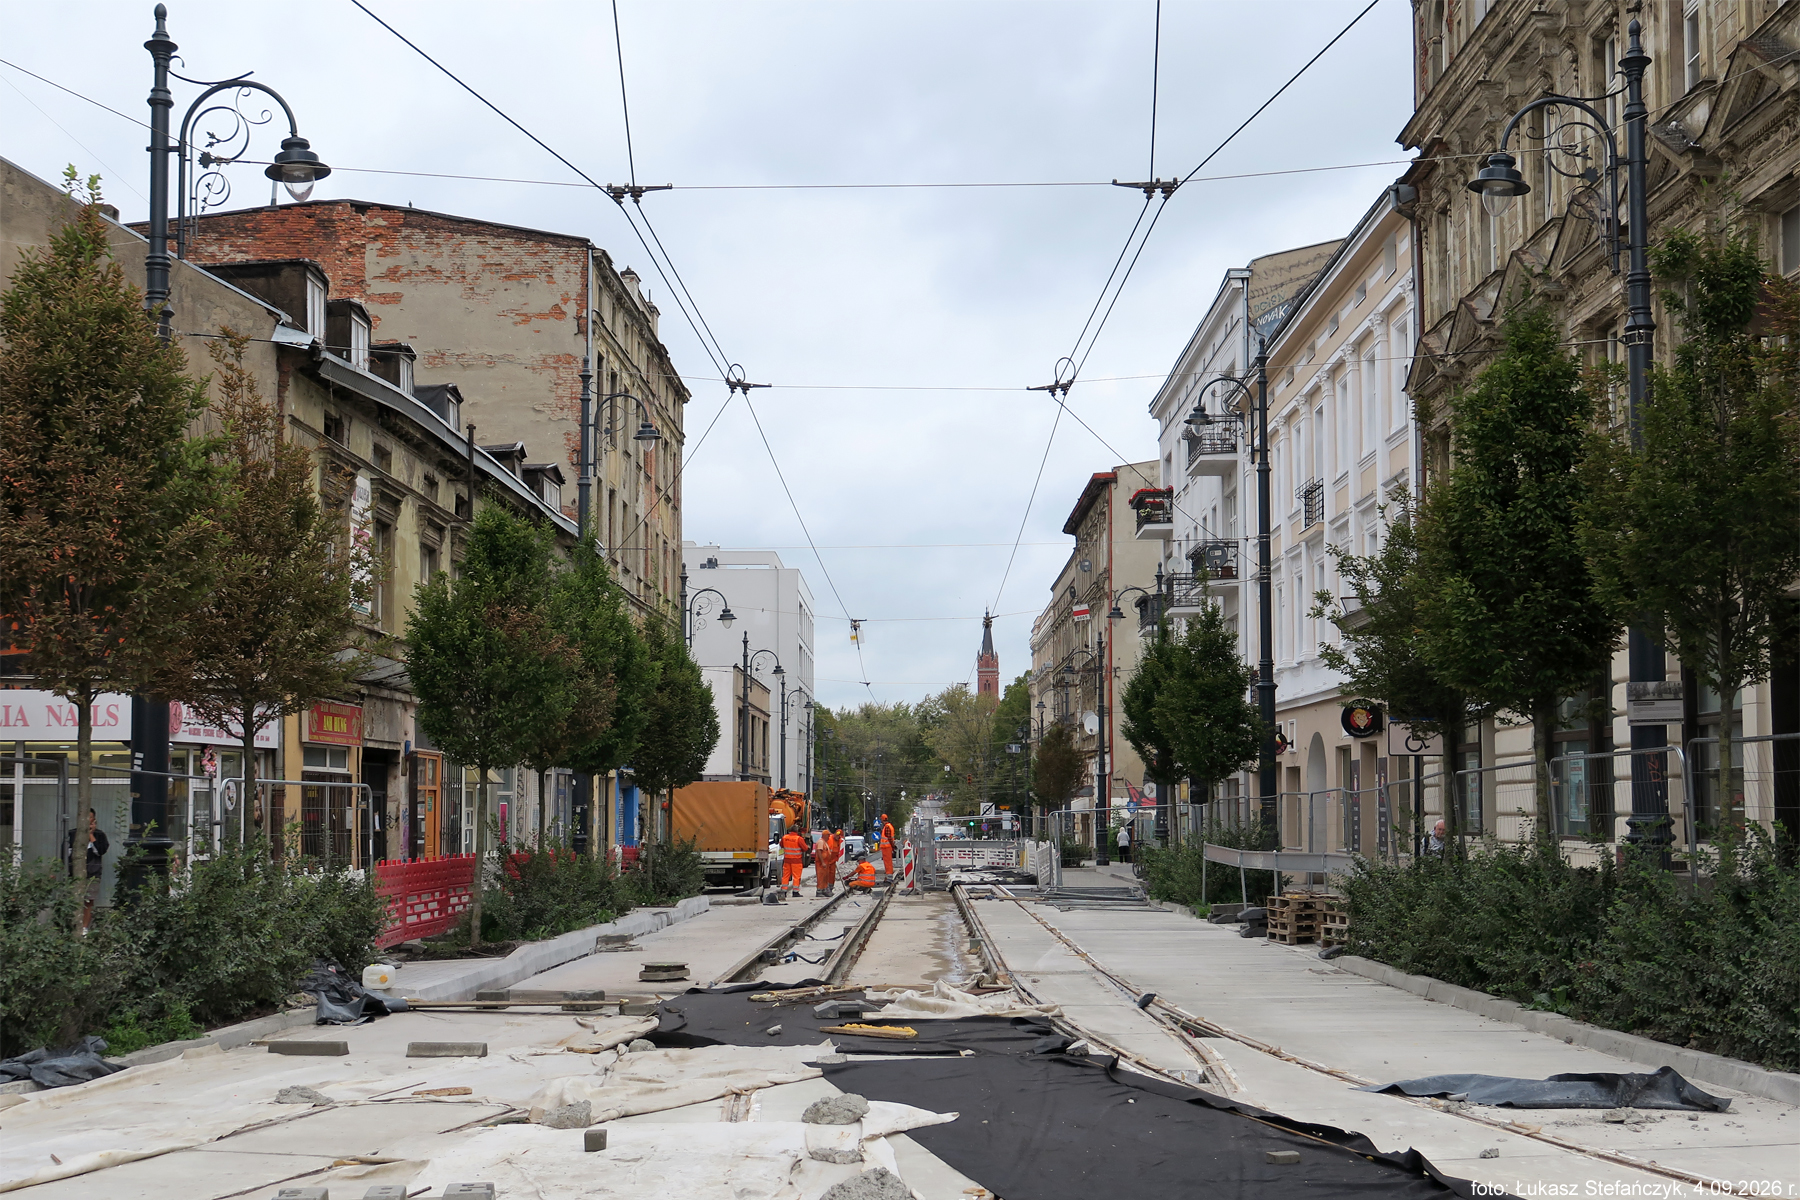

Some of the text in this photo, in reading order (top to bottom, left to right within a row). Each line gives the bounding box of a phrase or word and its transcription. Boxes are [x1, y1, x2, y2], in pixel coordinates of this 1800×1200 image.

[1256, 304, 1289, 326] NOVAK
[0, 704, 120, 727] IA NALS
